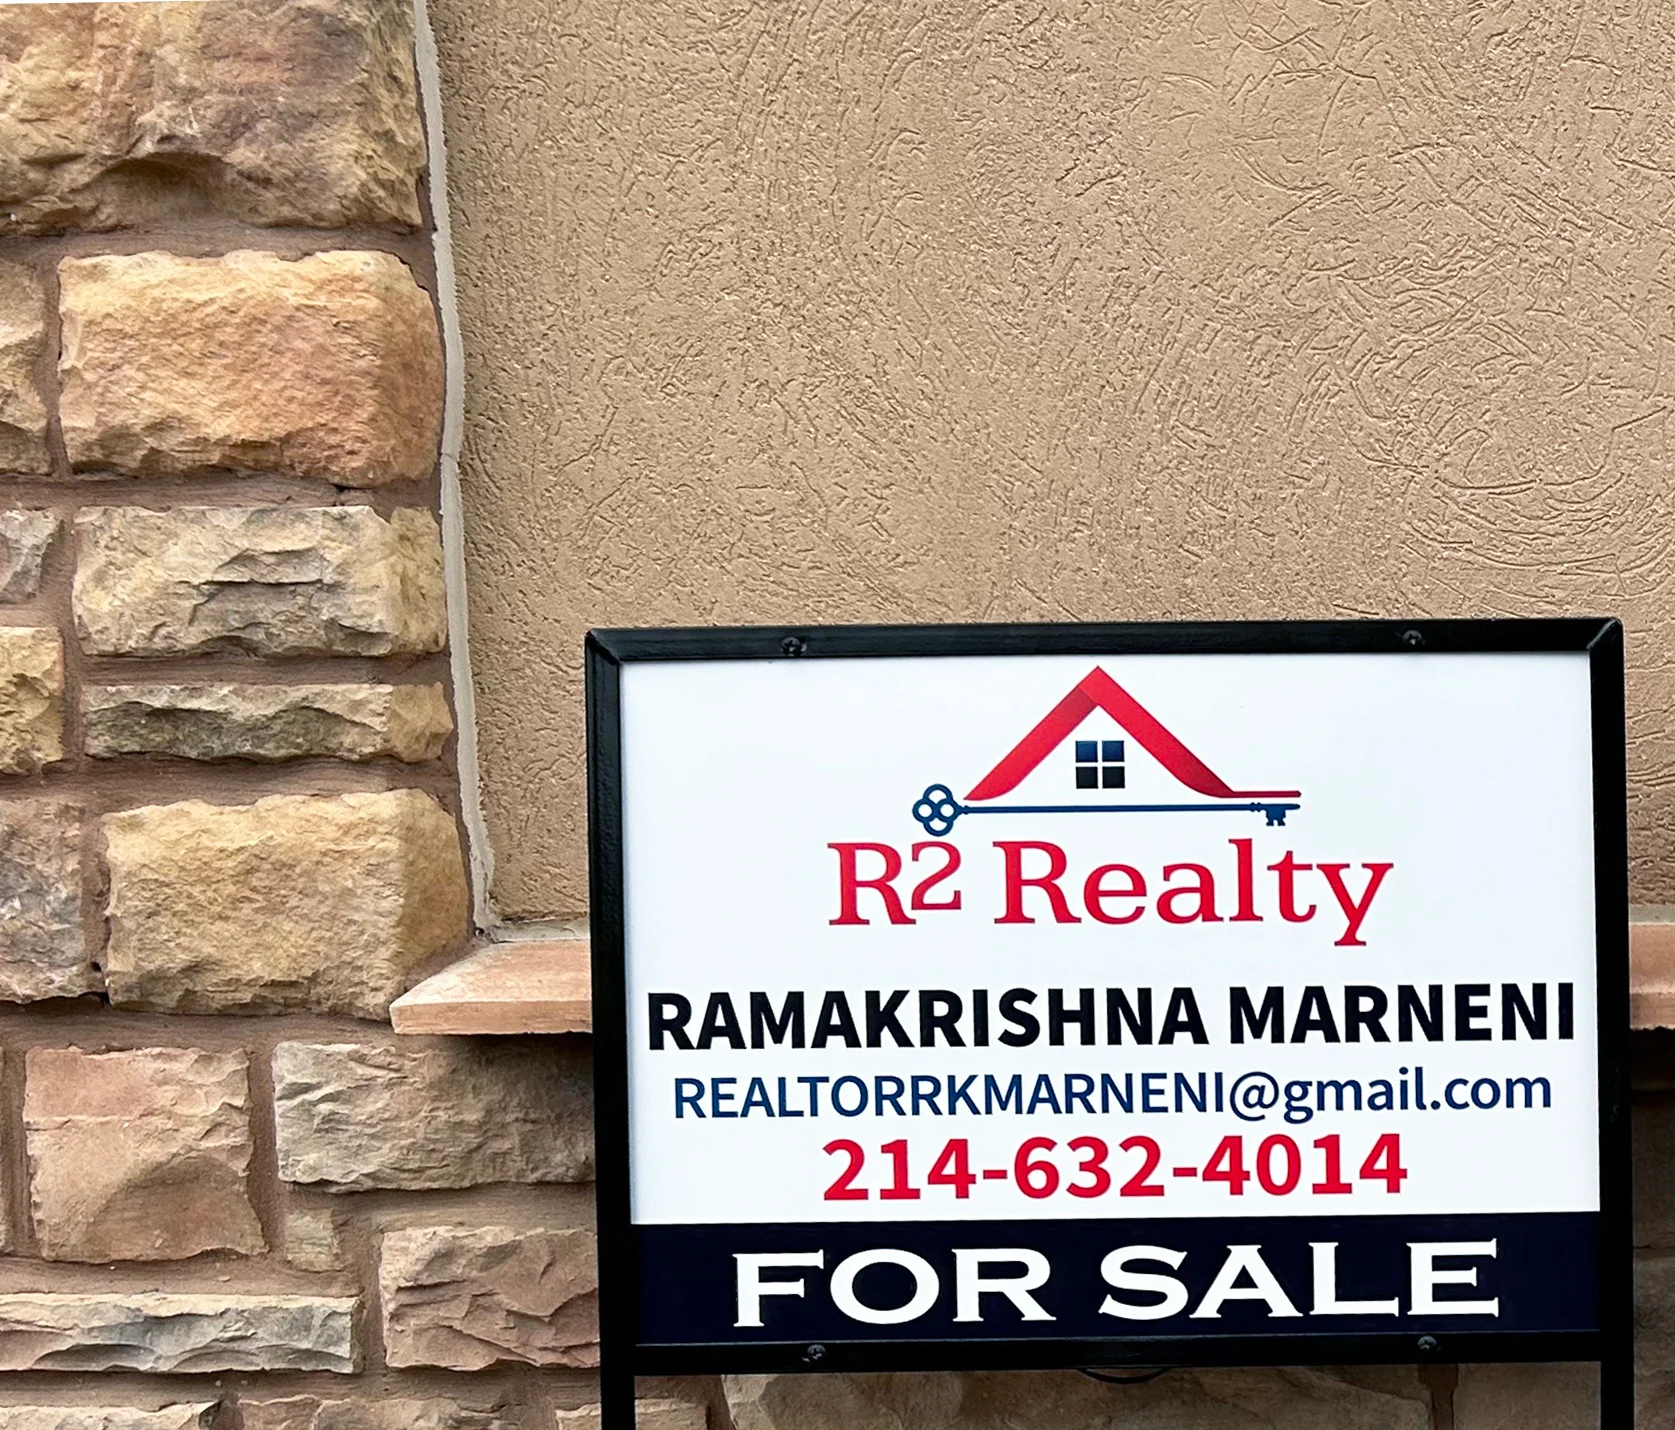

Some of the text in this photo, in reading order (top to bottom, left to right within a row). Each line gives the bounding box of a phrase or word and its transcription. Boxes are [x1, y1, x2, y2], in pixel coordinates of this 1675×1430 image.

[830, 839, 1392, 945] R2 Realty
[648, 983, 1573, 1050] RAMAKRISHNA MARNENI
[675, 1067, 1551, 1124] REALTORRKMARNENI@gmail.com
[824, 1133, 1407, 1200] 214-632-4014
[733, 1238, 1498, 1326] FOR SALE
